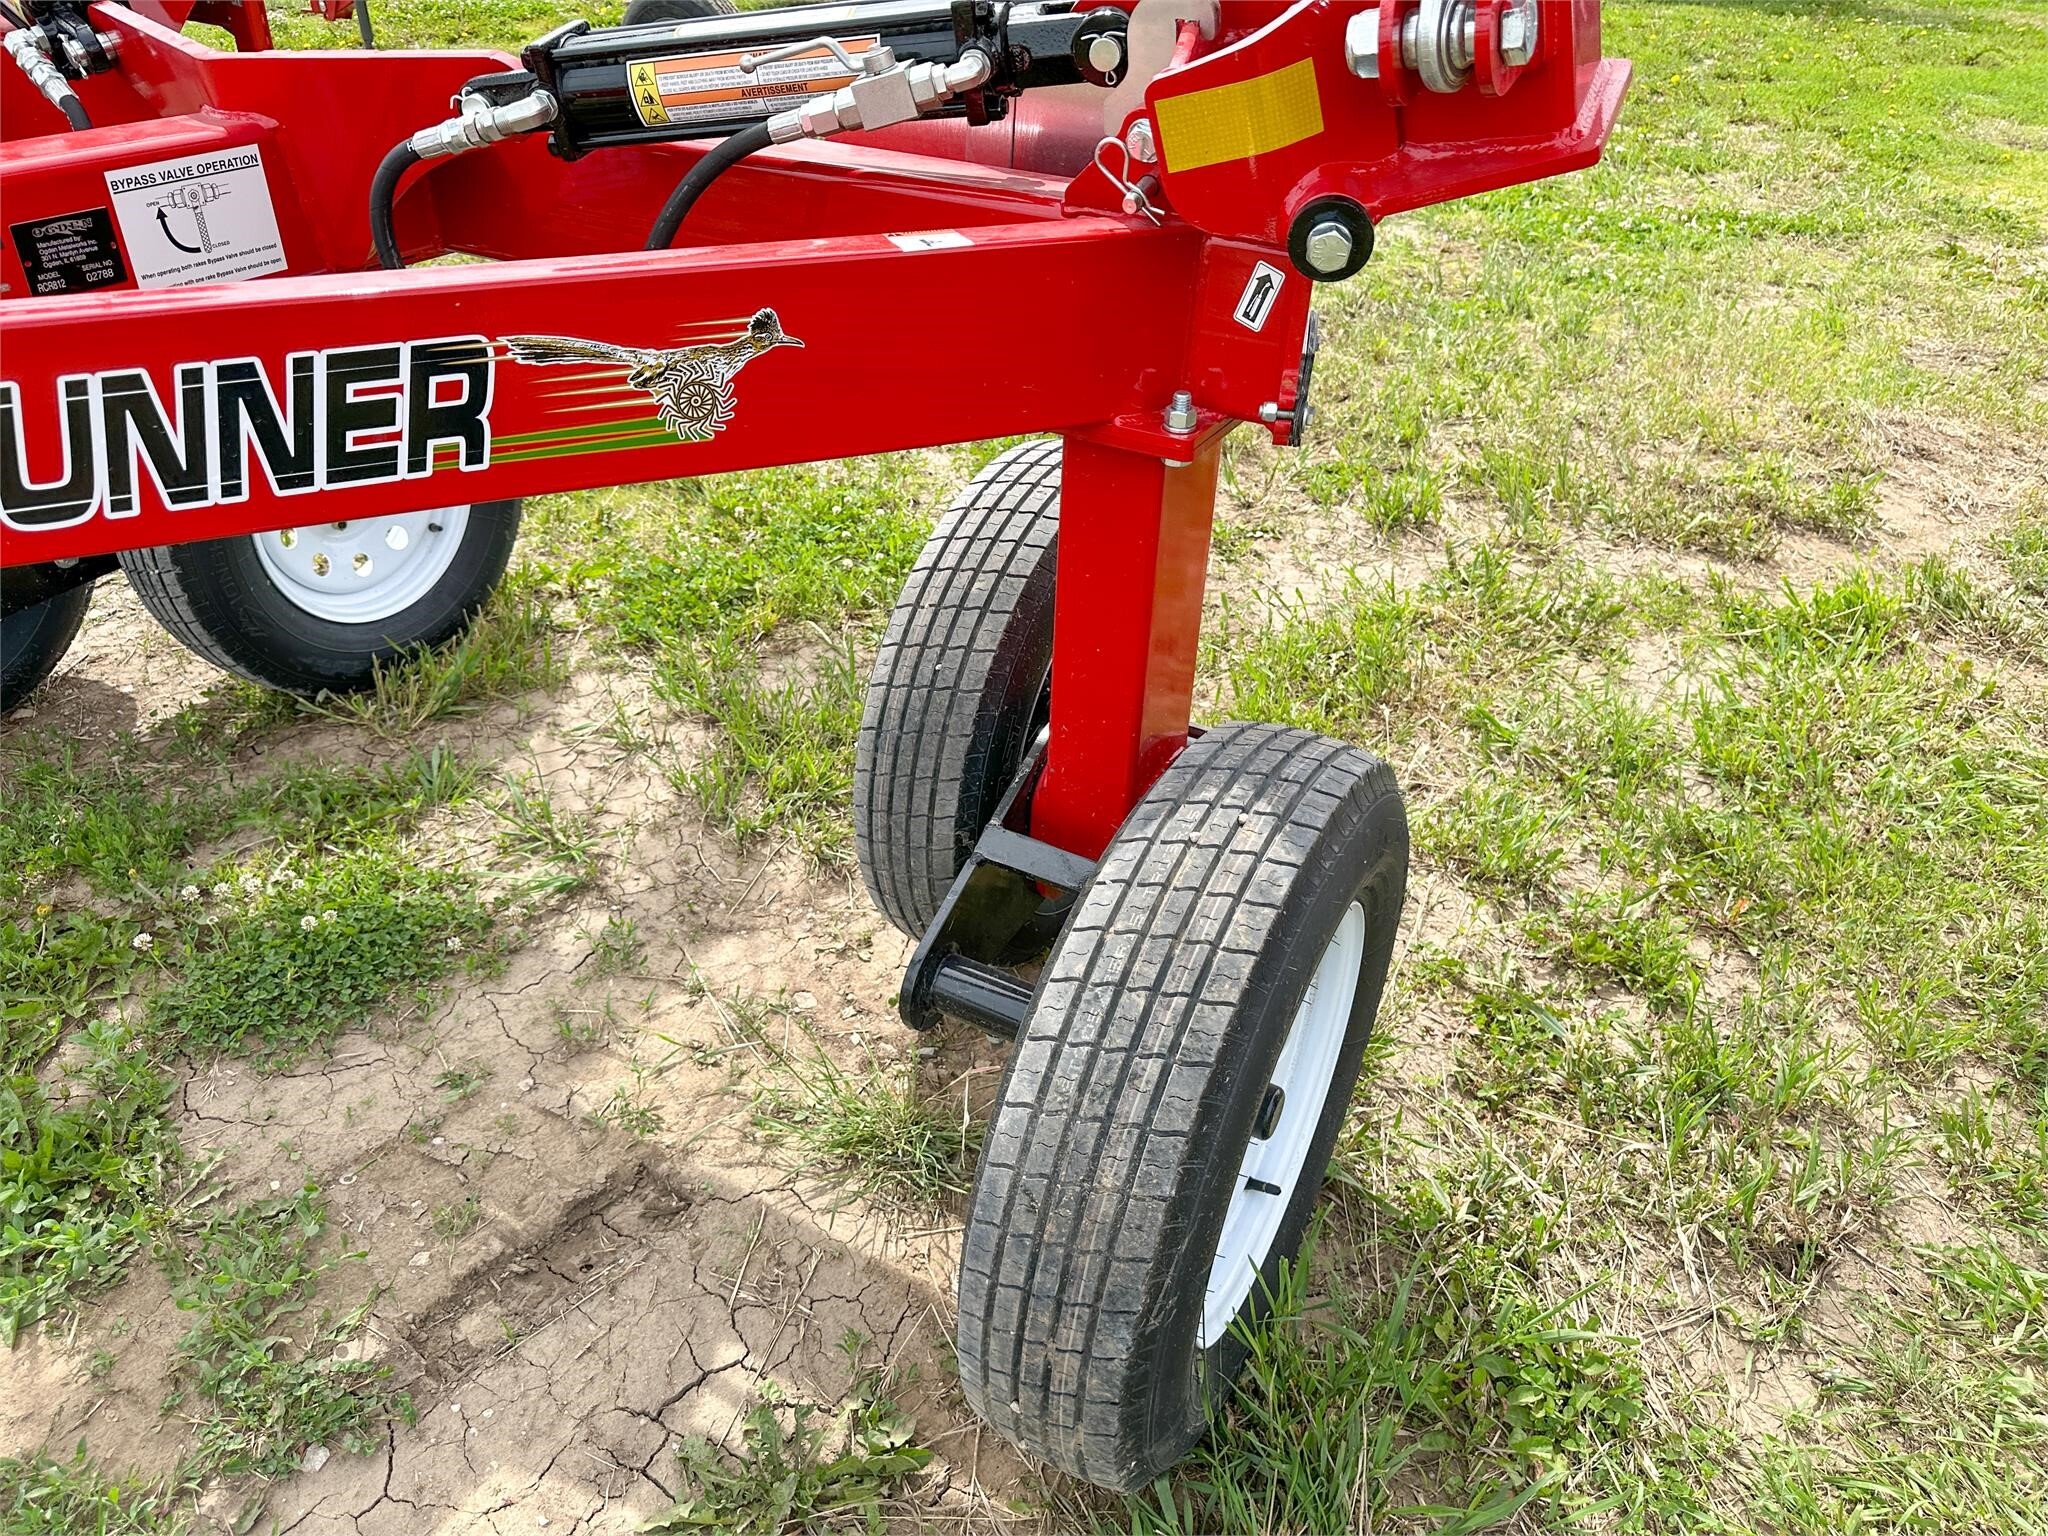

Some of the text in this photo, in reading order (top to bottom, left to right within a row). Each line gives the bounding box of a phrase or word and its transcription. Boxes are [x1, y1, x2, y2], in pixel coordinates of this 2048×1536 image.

[741, 83, 809, 97] AVERTISSEMENT
[110, 153, 259, 191] BYPASS VALVE OPERATION
[79, 245, 99, 254] Avenue
[212, 240, 231, 248] CLOSED
[39, 247, 58, 256] Ogden
[81, 261, 103, 271] SERIAL
[141, 271, 157, 281] When
[157, 266, 181, 278] operating
[181, 263, 193, 271] both
[193, 260, 207, 268] rakes
[207, 256, 225, 265] Bypass
[225, 252, 239, 260] Valve
[239, 248, 255, 257] should
[262, 242, 278, 250] closed
[216, 269, 234, 277] Bypass
[234, 265, 248, 273] Valve
[247, 261, 263, 270] should
[38, 272, 60, 281] MODEL
[86, 269, 115, 282] 02788
